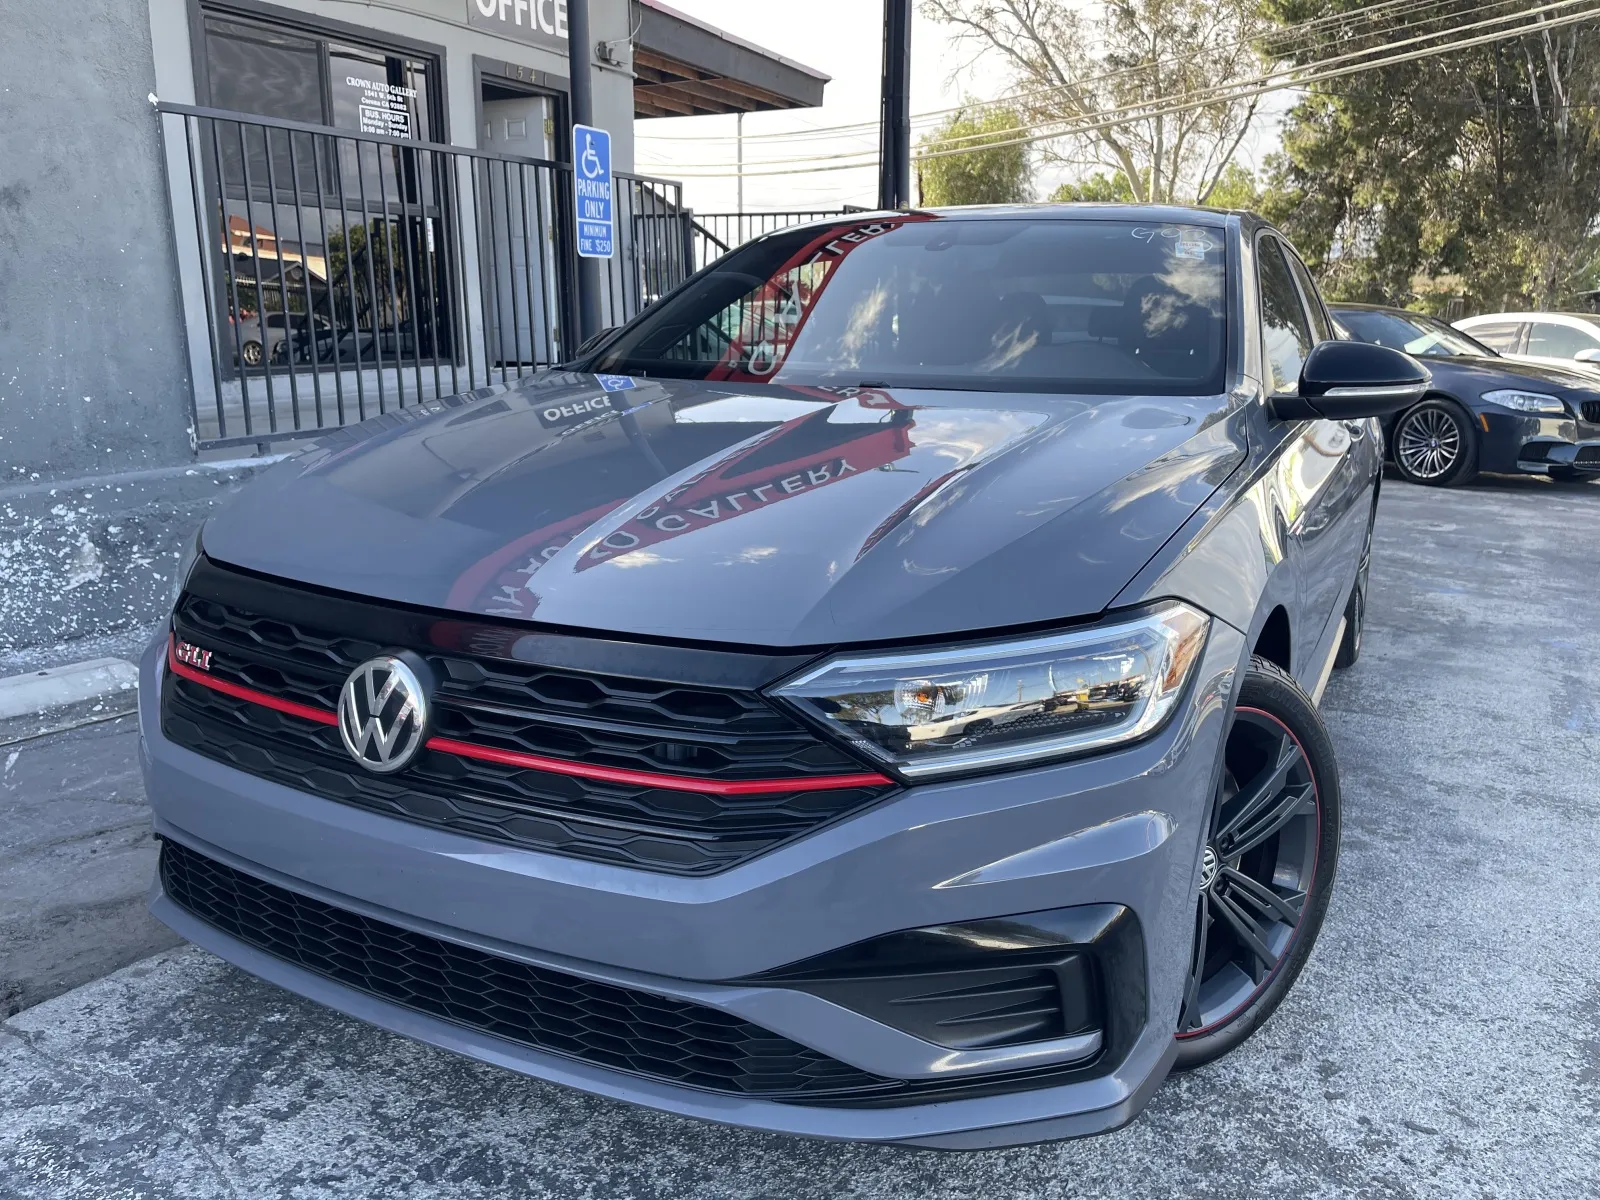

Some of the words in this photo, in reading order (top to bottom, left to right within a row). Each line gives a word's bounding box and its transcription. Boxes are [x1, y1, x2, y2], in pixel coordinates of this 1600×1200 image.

[346, 76, 371, 89] CROWN
[371, 82, 390, 93] AUTO
[390, 85, 417, 98] GALLERY
[362, 116, 385, 128] Monday
[388, 121, 408, 132] Sunday
[381, 112, 405, 123] HOURS
[578, 178, 610, 200] PARKING
[584, 200, 605, 219] ONLY
[583, 223, 607, 238] MINIMUM
[580, 238, 593, 252] FINE
[595, 239, 611, 254] $250
[175, 641, 212, 670] GLI
